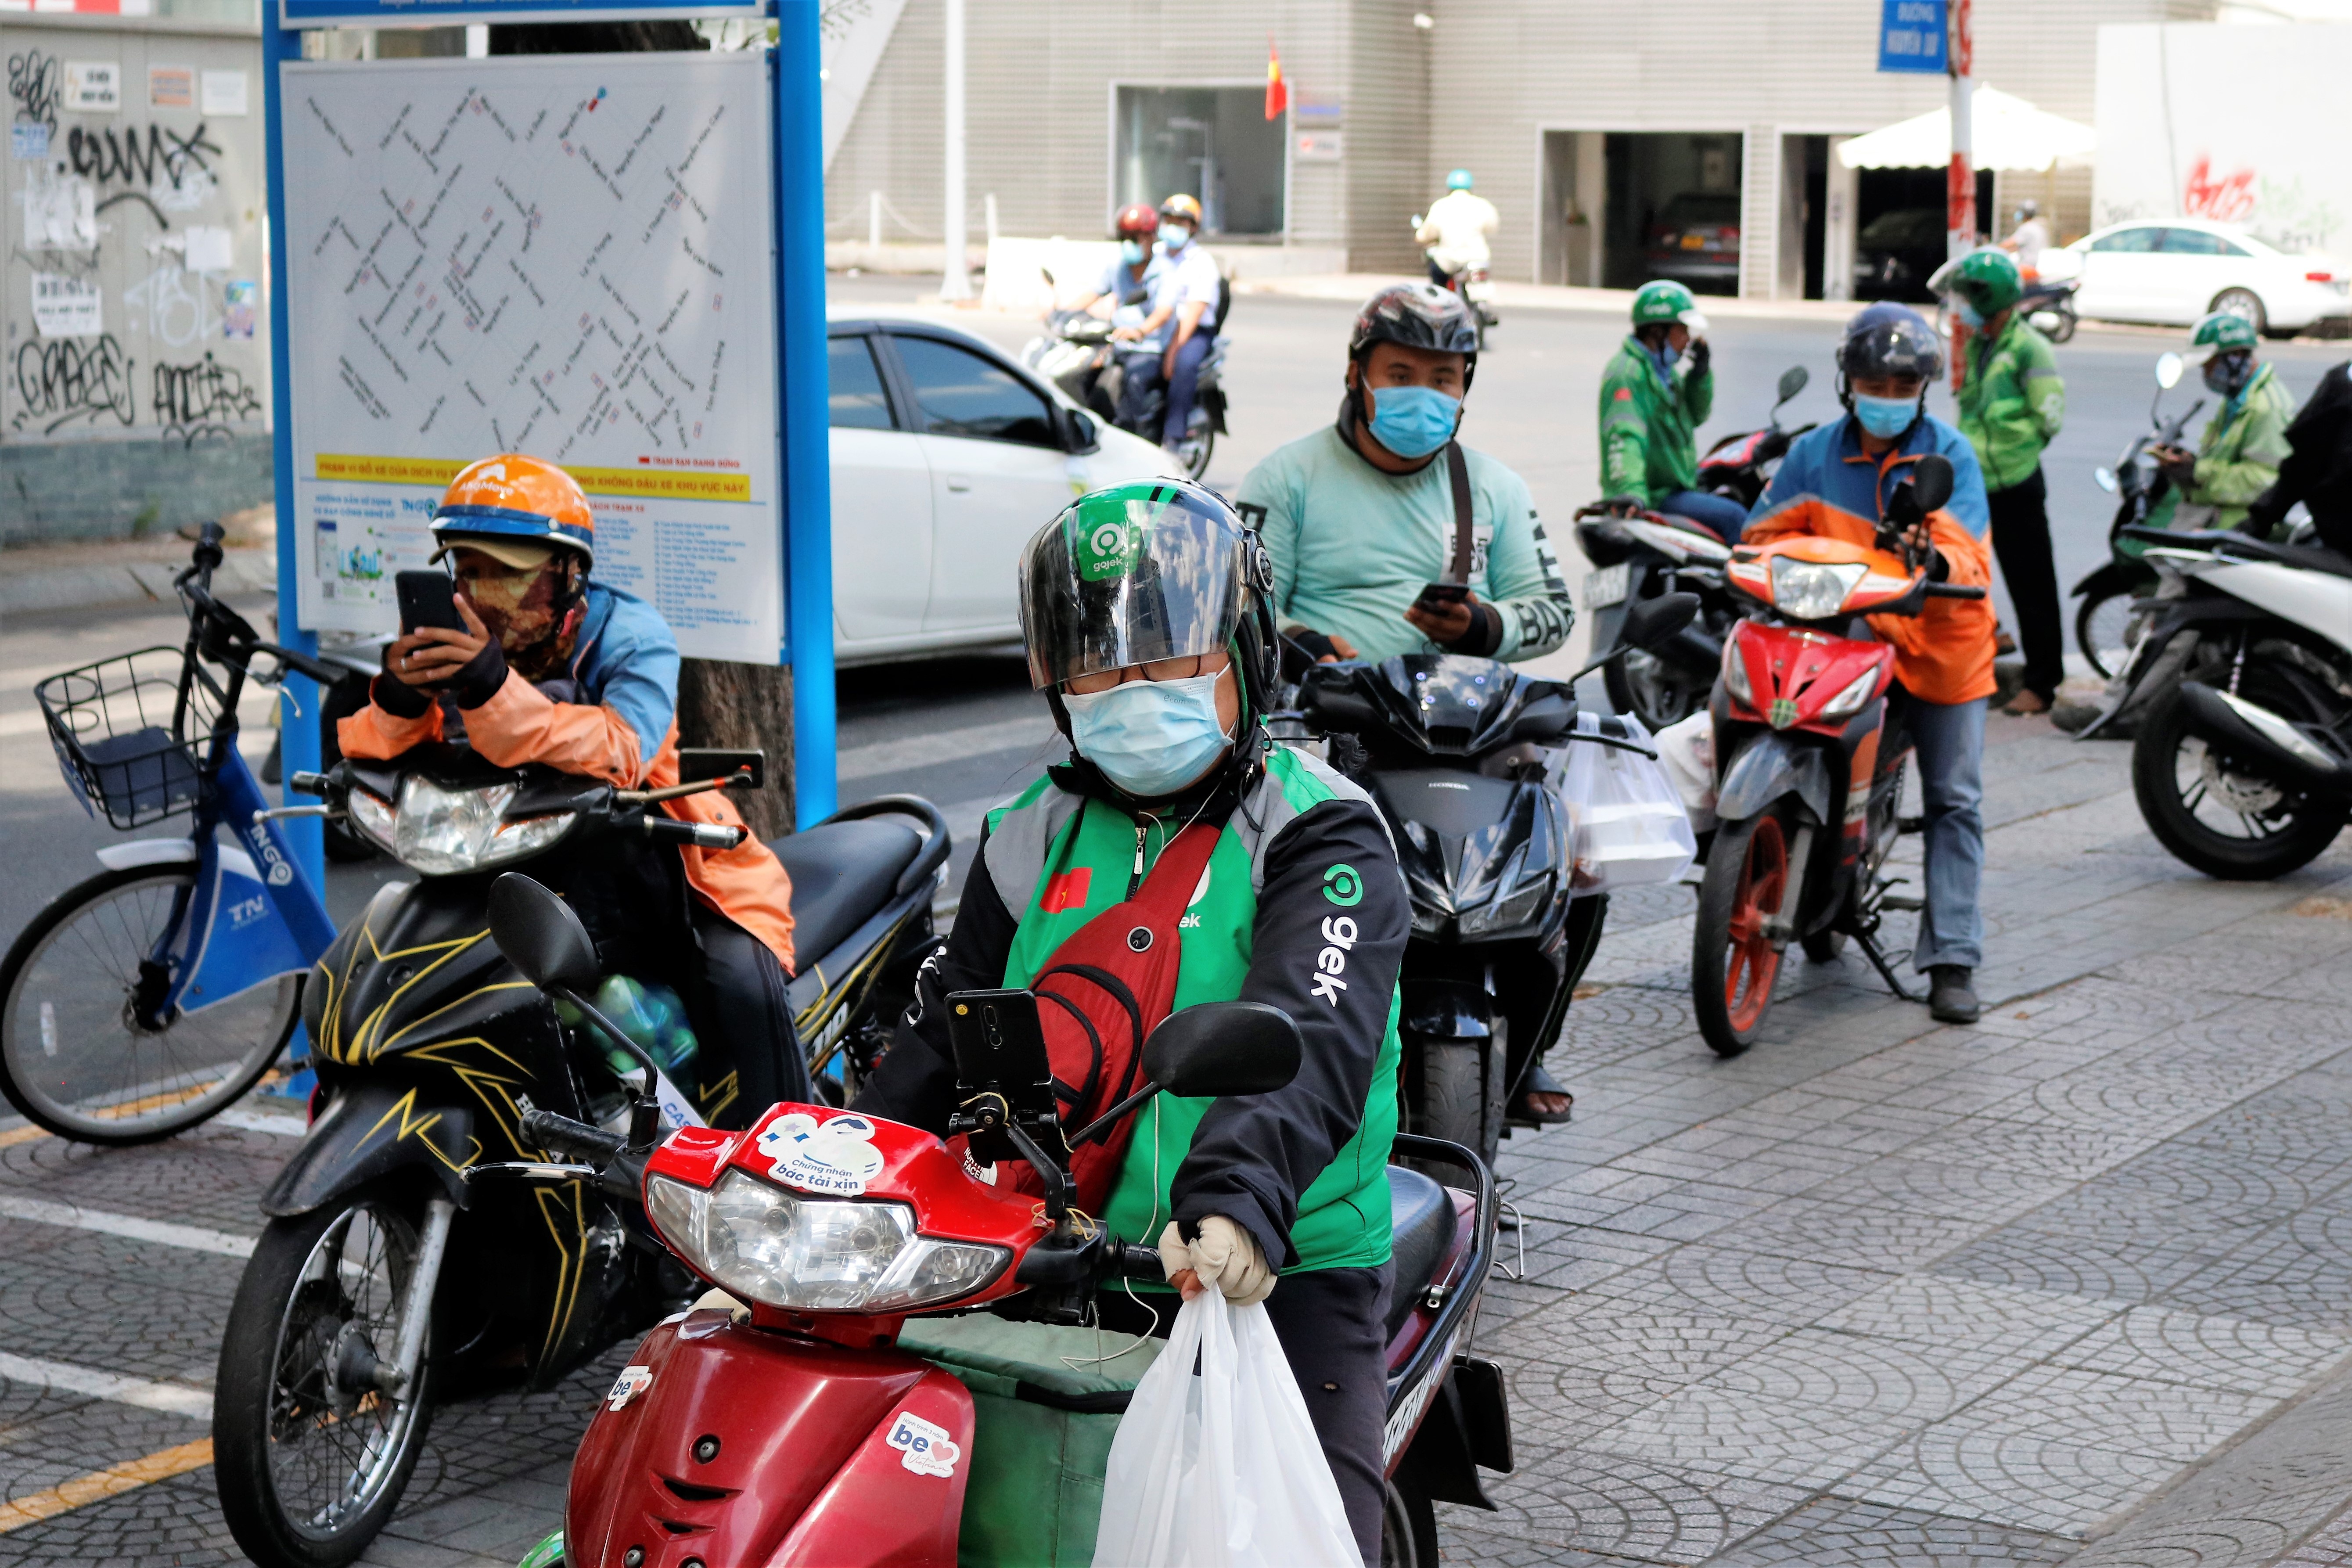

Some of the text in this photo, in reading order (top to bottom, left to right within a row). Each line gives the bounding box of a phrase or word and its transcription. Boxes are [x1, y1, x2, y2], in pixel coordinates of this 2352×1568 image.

[1093, 557, 1123, 572] gojek
[776, 1163, 859, 1192] bác tài xịn
[792, 1159, 852, 1178] Chứng nhận
[963, 1160, 981, 1179] FACE
[611, 1379, 631, 1395] be
[903, 1417, 916, 1427] Hành
[916, 1423, 928, 1432] trình
[932, 1431, 944, 1440] năm
[893, 1424, 928, 1453] be
[908, 1453, 949, 1472] Vietnam
